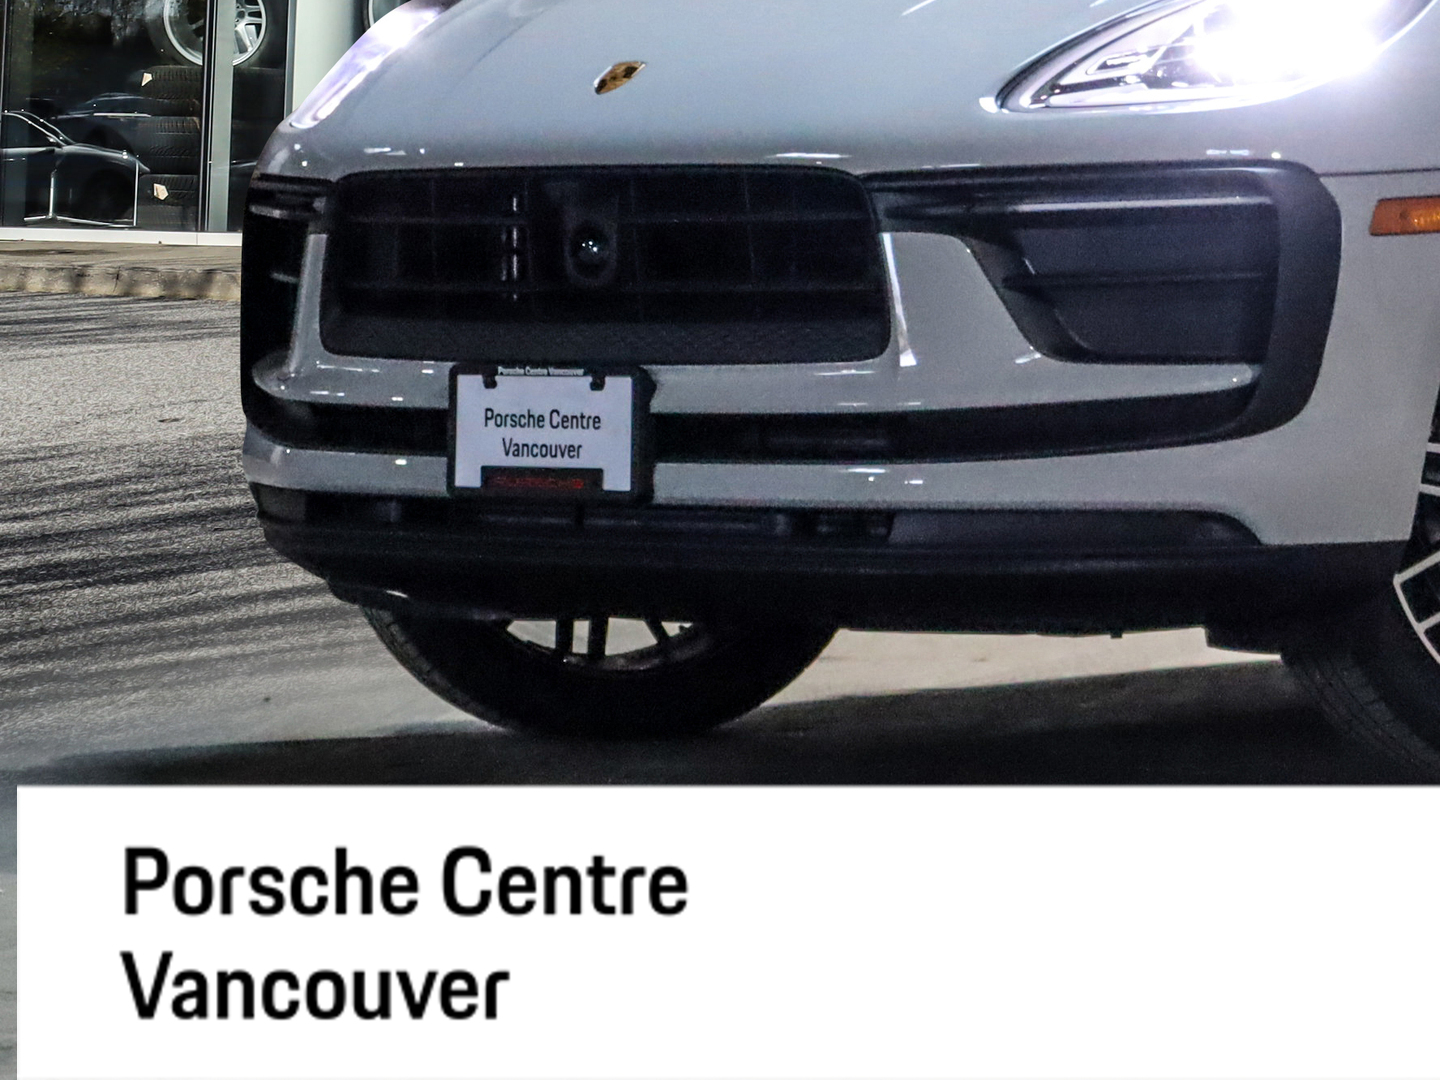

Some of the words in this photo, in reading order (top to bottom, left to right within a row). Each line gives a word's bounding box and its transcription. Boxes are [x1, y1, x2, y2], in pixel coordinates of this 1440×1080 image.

[484, 407, 545, 428] Porsche
[549, 409, 601, 430] Centre
[502, 437, 583, 459] Vancouver
